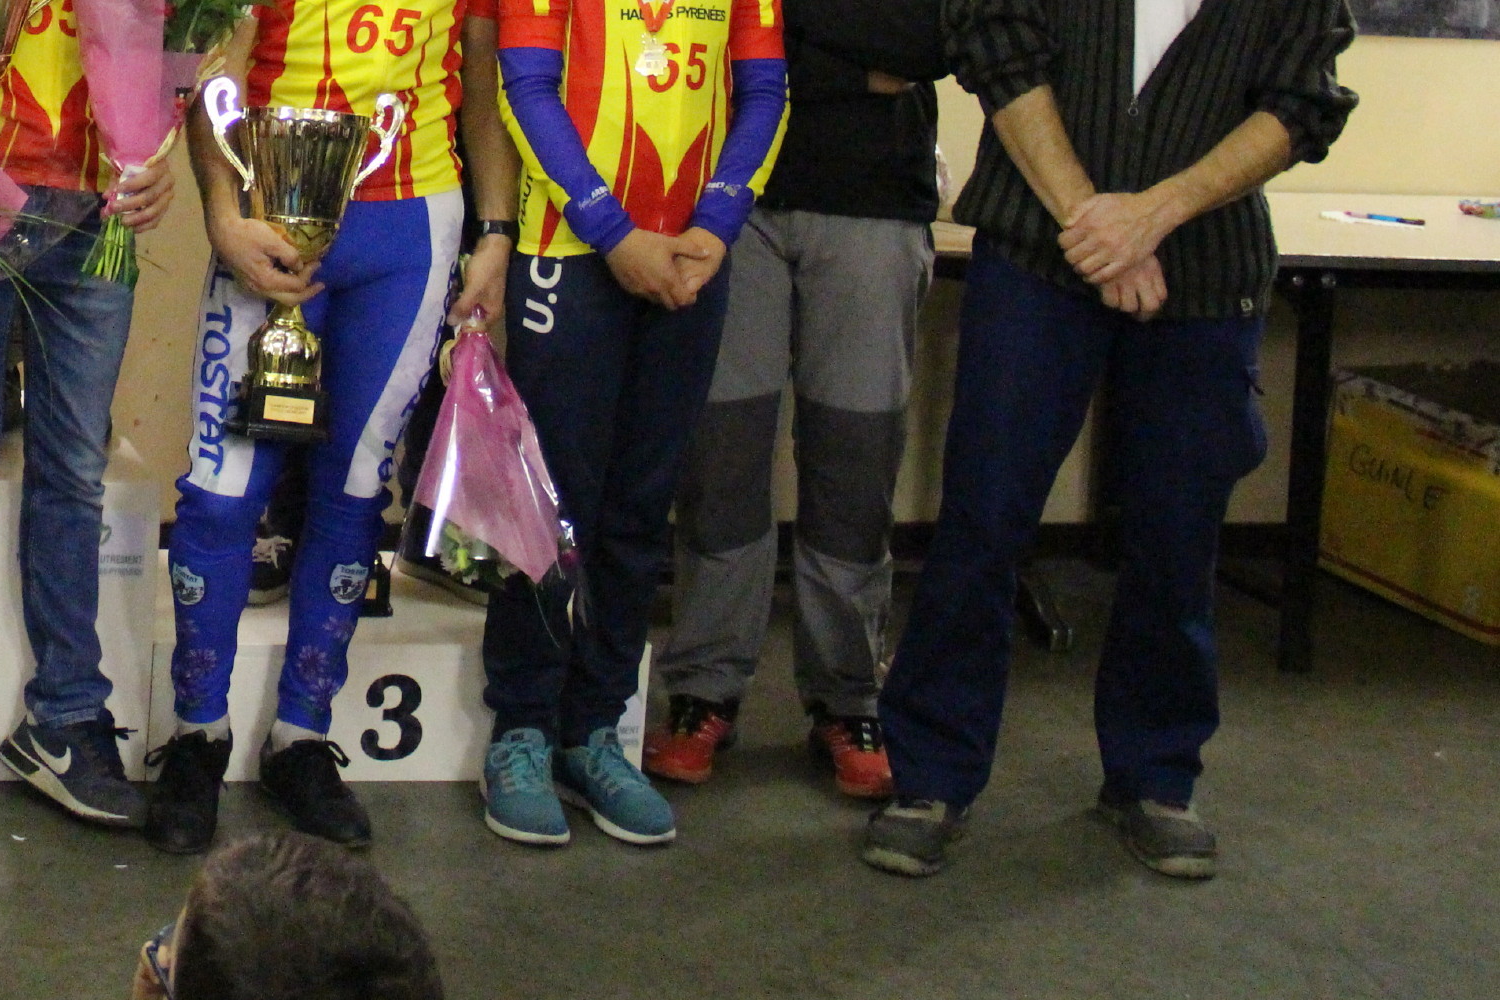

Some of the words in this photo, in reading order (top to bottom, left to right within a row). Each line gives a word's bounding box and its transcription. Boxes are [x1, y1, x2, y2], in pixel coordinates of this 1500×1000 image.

[346, 4, 422, 58] 65
[621, 8, 674, 21] HAUS
[676, 4, 726, 22] PYRÉNÉES
[647, 42, 708, 93] 65
[199, 304, 233, 477] TOSTAT
[361, 673, 424, 761] 3
